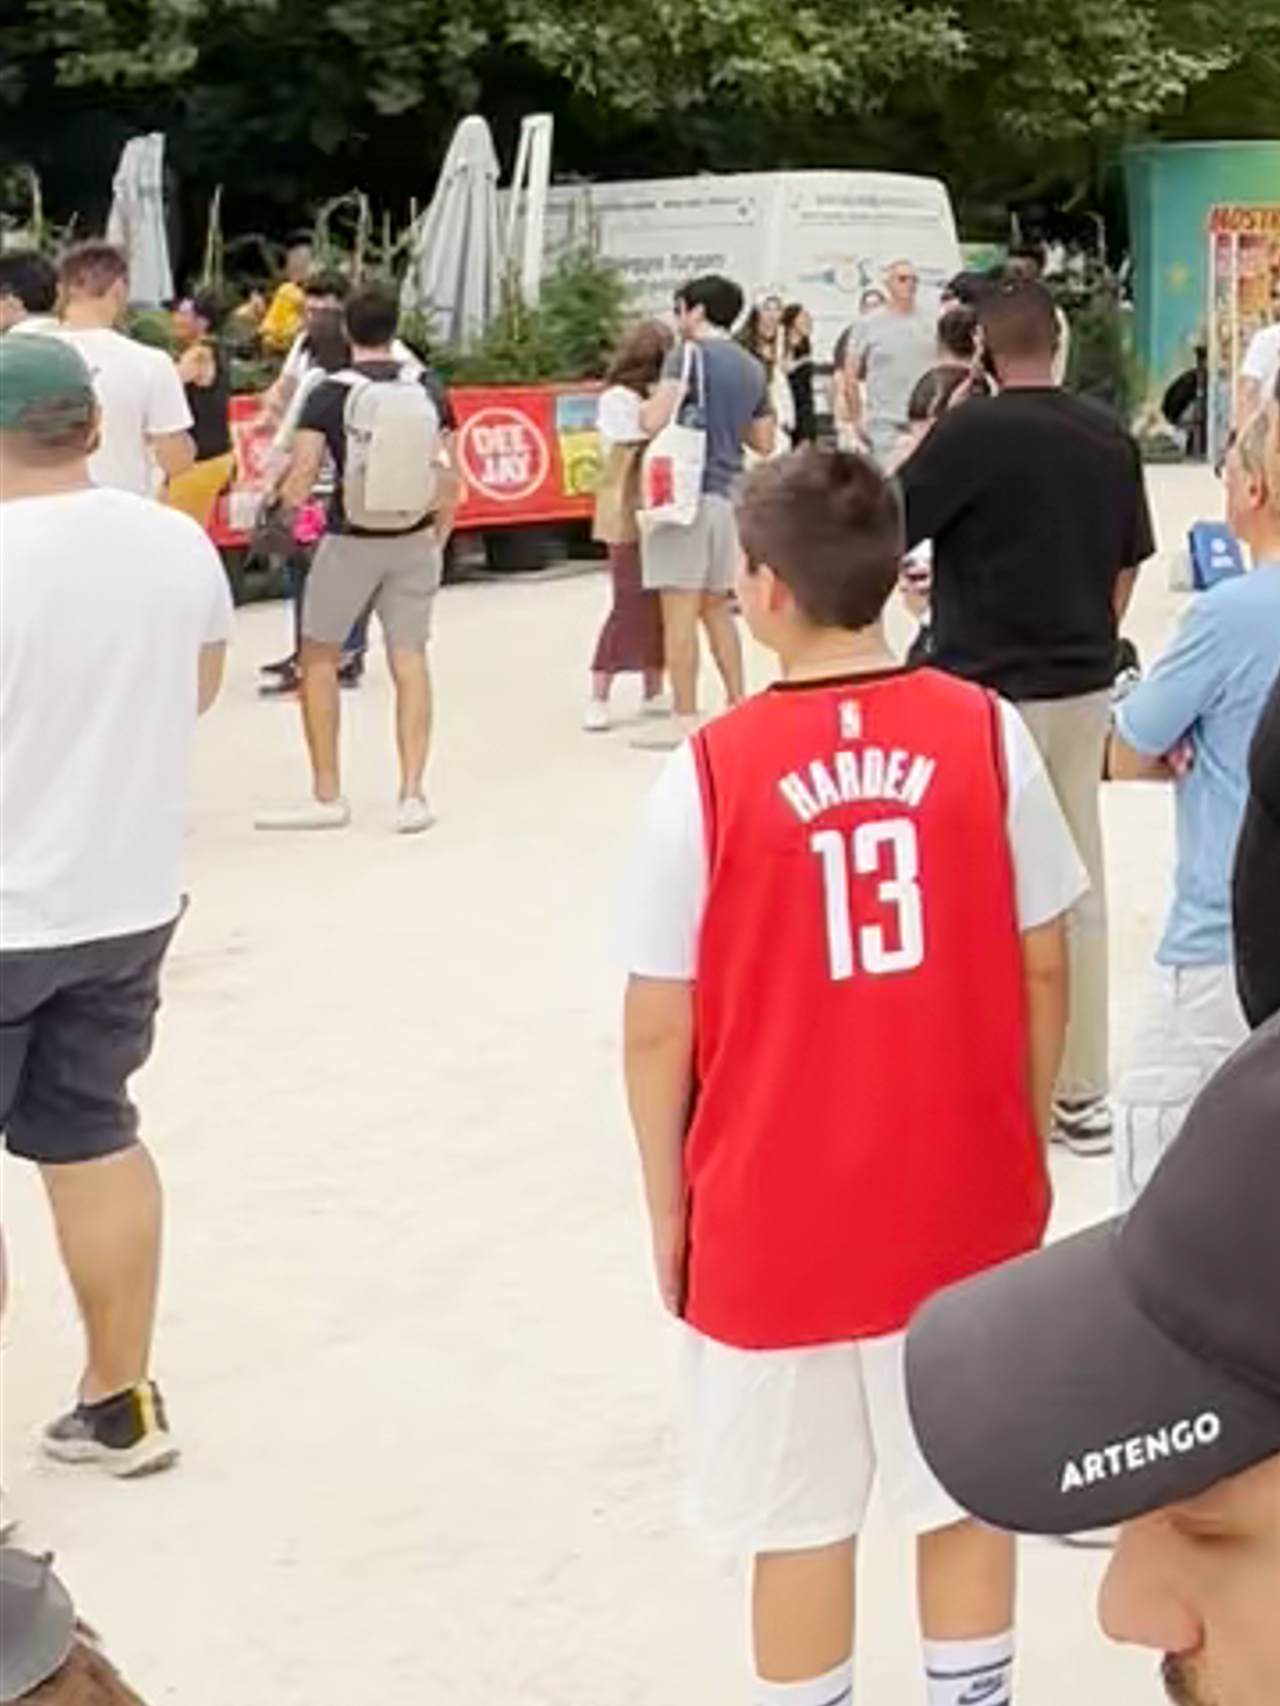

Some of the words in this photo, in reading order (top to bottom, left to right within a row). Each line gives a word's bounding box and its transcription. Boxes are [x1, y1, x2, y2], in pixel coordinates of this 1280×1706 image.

[777, 746, 936, 823] HARDEN
[810, 817, 925, 982] 13
[1060, 1411, 1221, 1493] ARTENGO
